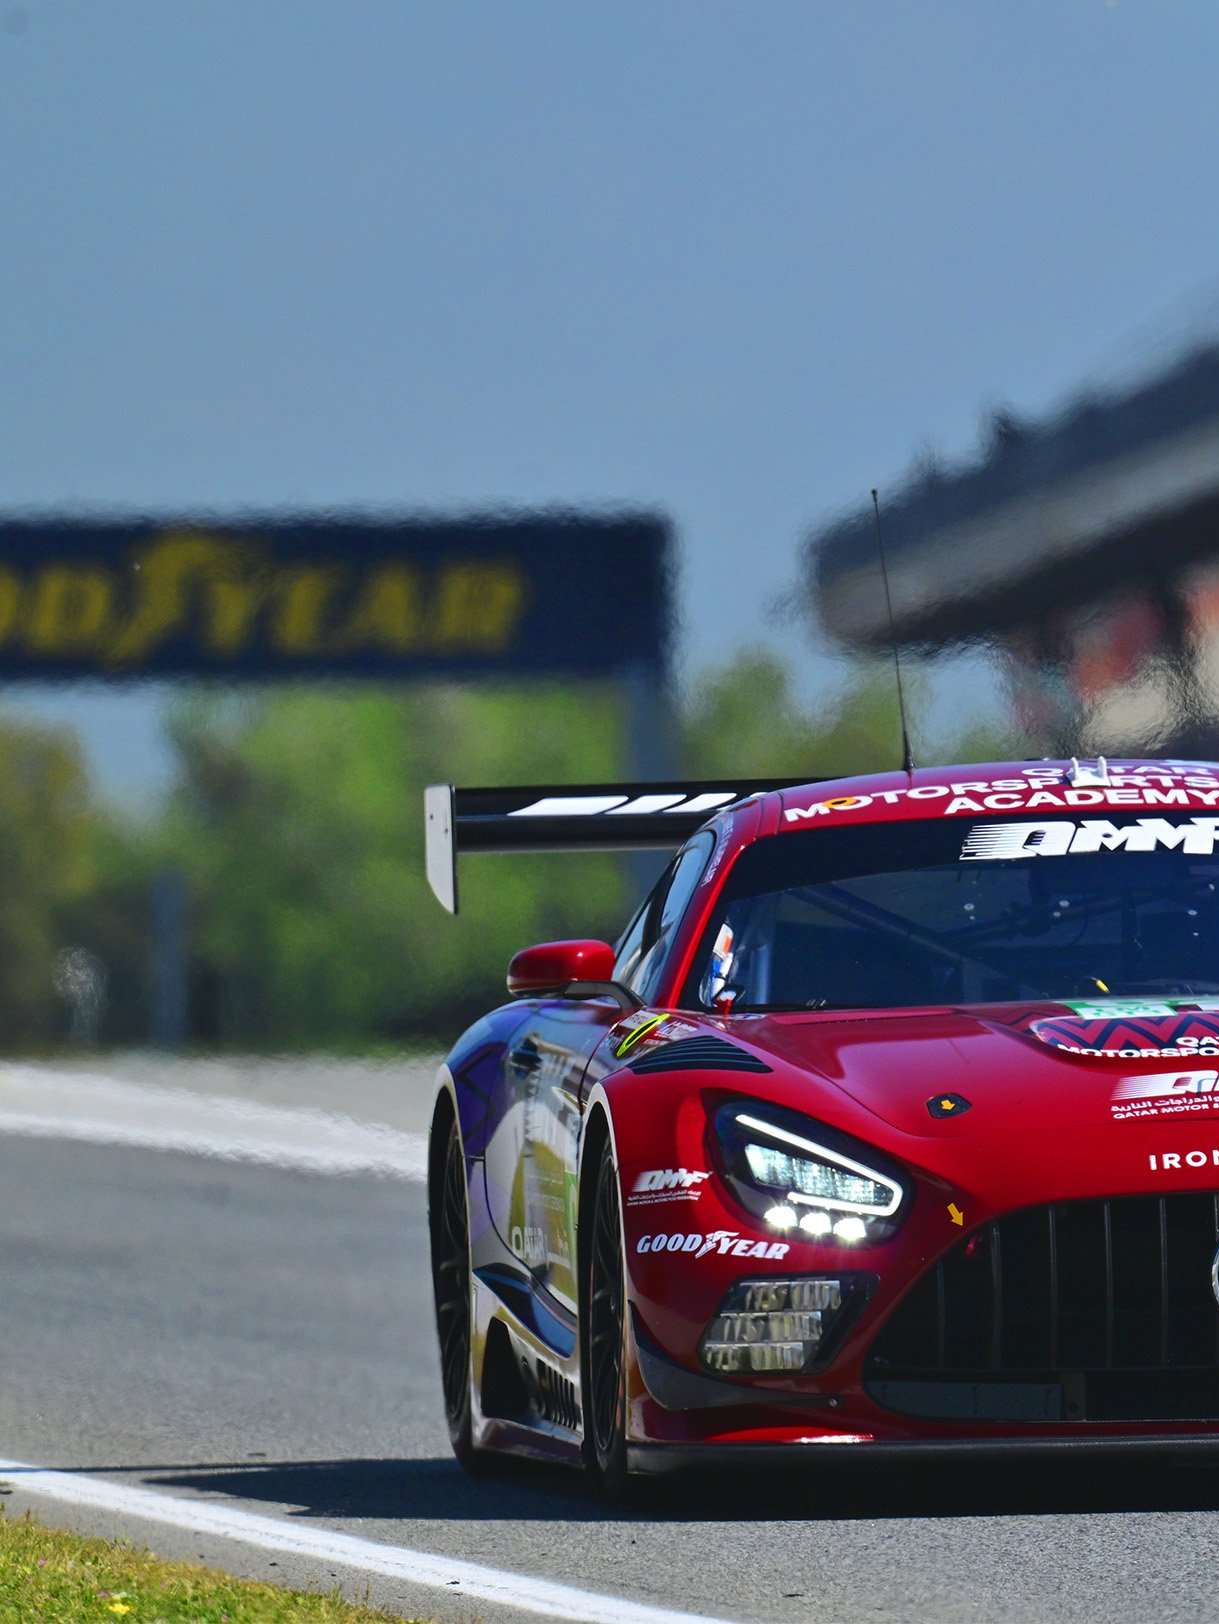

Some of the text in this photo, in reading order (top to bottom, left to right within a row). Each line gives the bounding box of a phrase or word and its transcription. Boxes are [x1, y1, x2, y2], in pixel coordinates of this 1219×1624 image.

[1021, 765, 1213, 777] QTAR
[1113, 1109, 1159, 1120] QATAR
[1161, 1105, 1210, 1114] MOTOR
[636, 1231, 790, 1260] GOODYEAR
